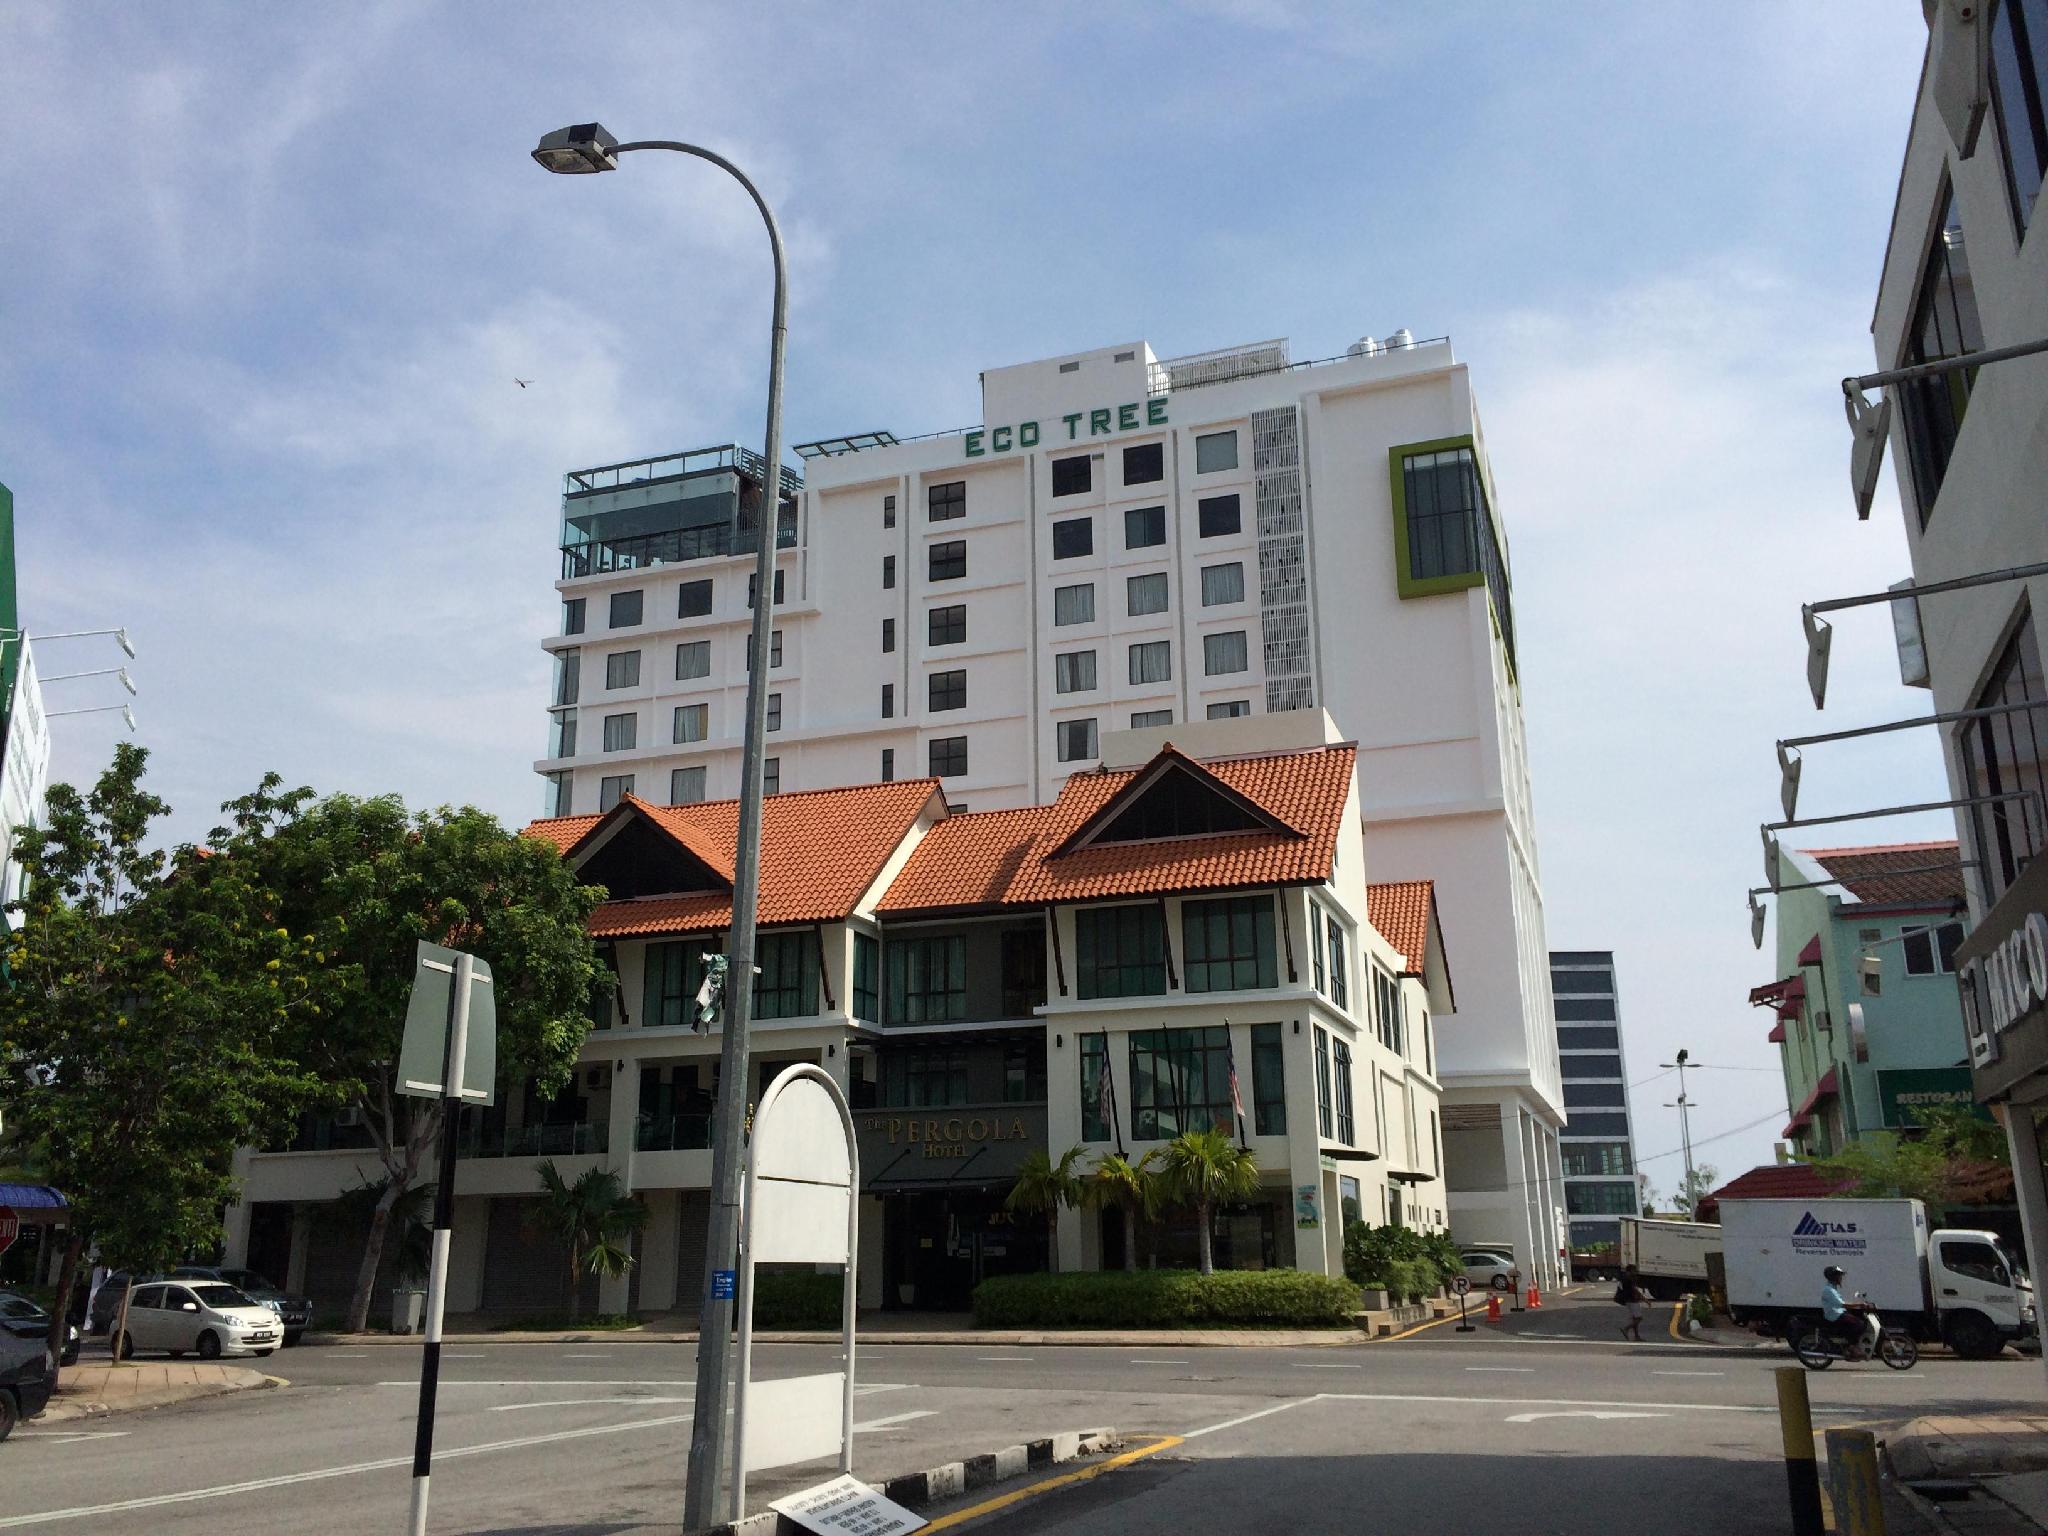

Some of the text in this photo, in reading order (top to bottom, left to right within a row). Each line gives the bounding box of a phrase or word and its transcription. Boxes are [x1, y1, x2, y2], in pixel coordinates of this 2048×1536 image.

[965, 398, 1169, 458] ECO TREE
[888, 1117, 1027, 1143] PERGOLA
